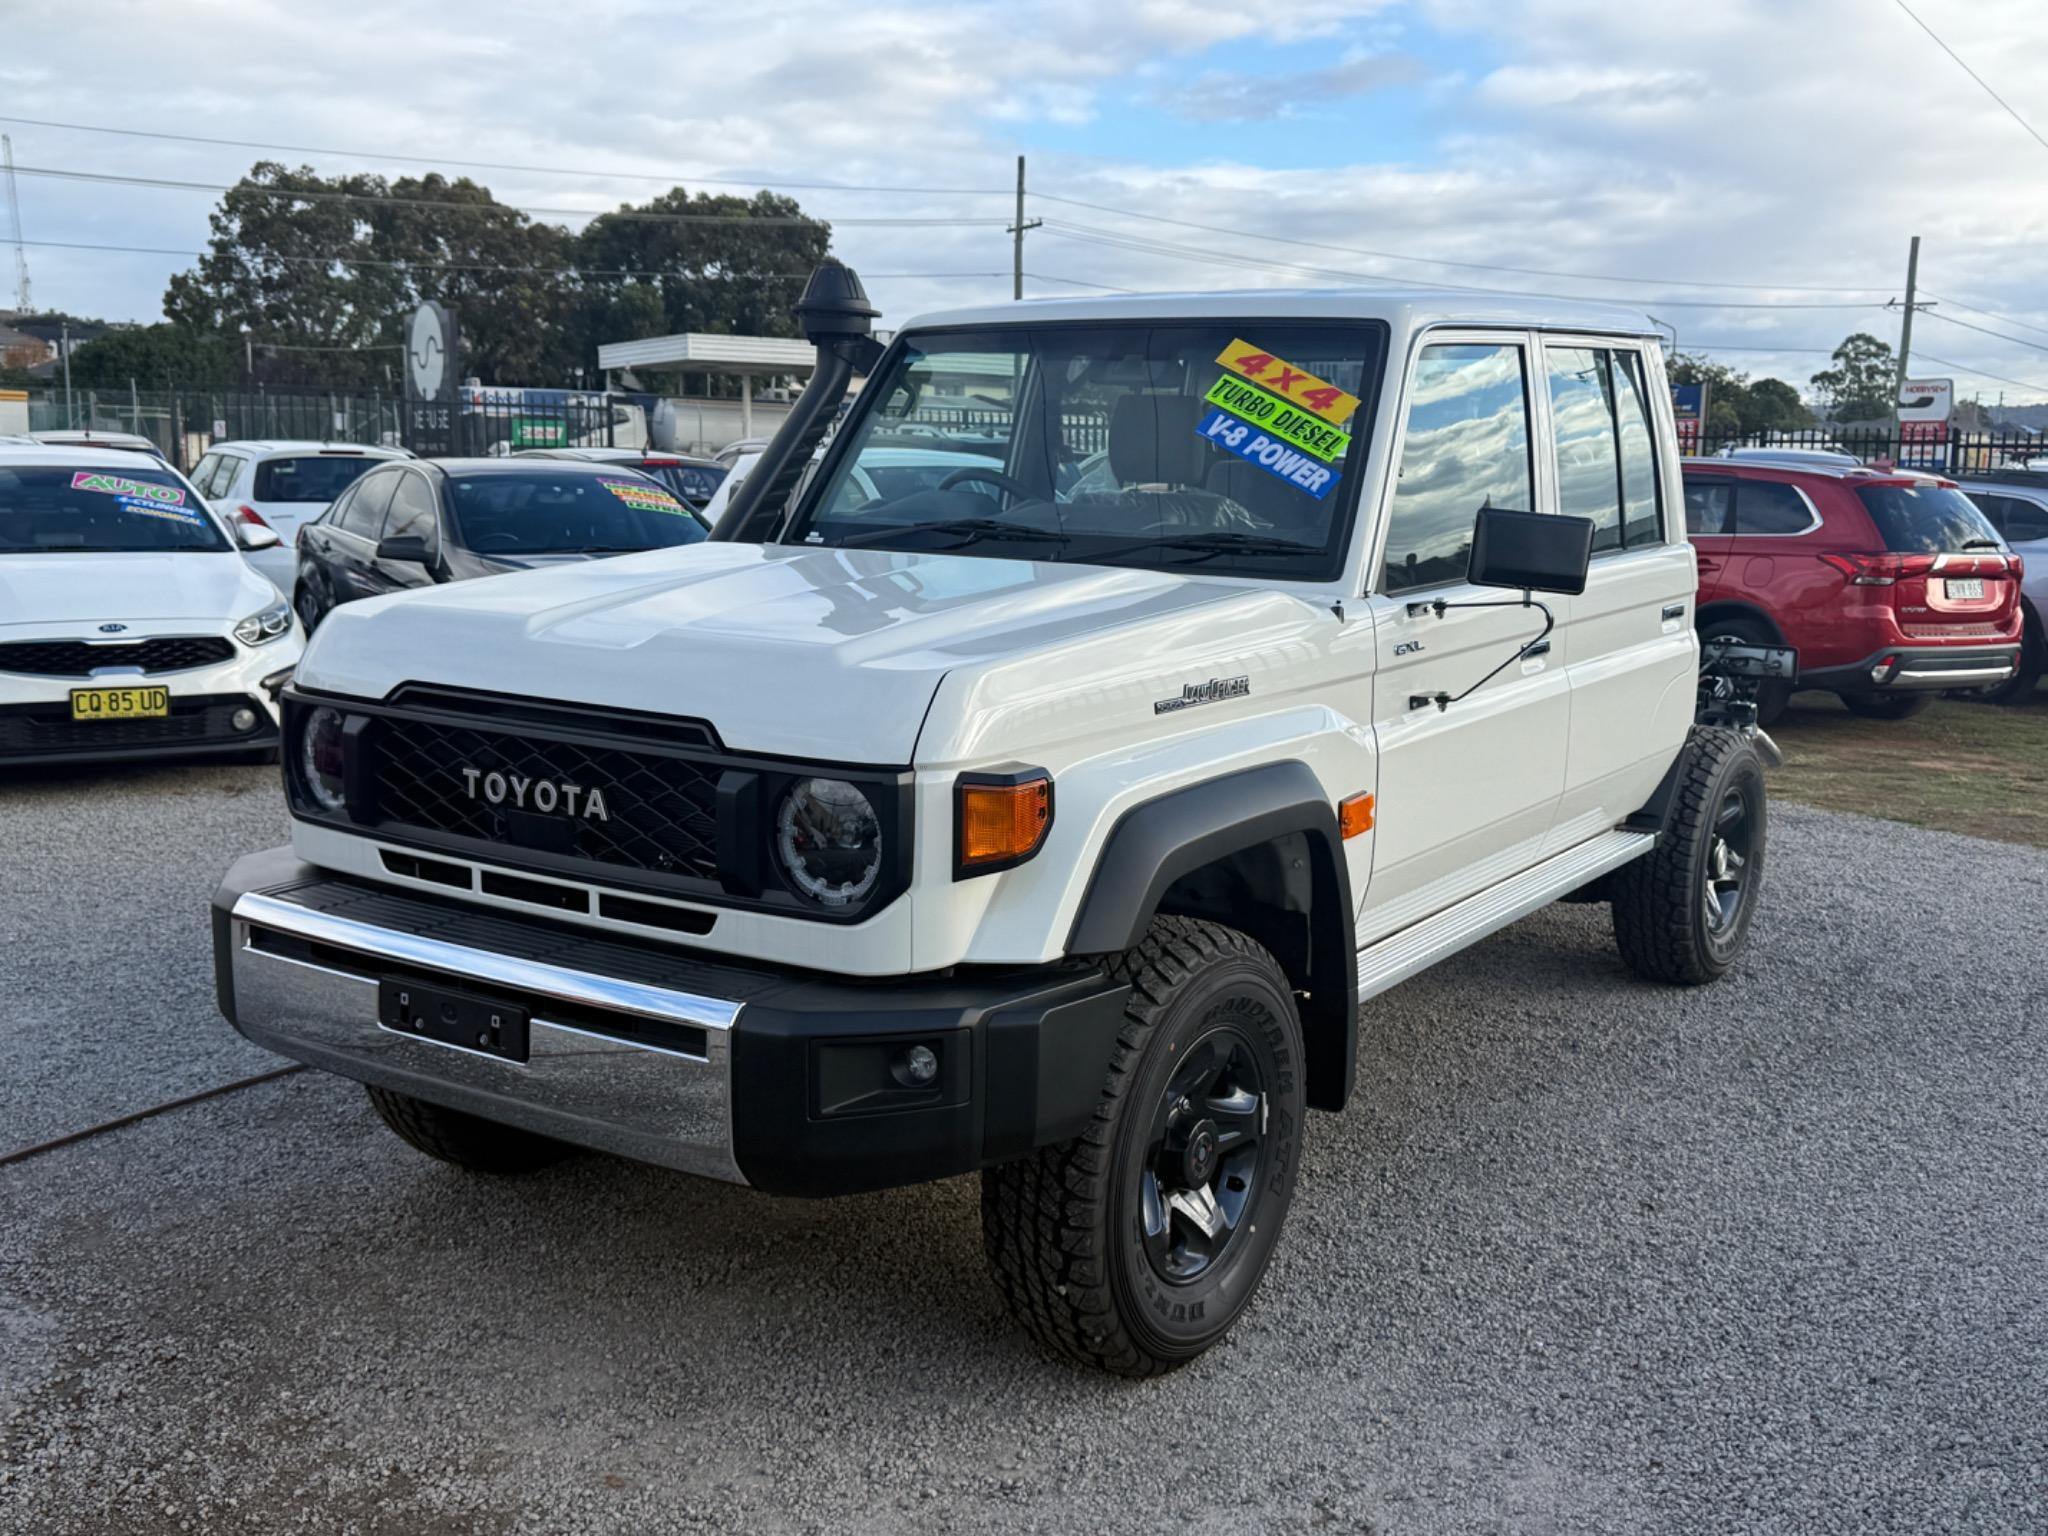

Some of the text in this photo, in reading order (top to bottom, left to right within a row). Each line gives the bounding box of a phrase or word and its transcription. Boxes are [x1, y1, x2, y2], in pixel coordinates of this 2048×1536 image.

[1211, 378, 1343, 455] TURBO DIESEL
[79, 475, 182, 503] AUTO
[1242, 435, 1331, 493] POWER
[463, 768, 608, 821] TOYOTA
